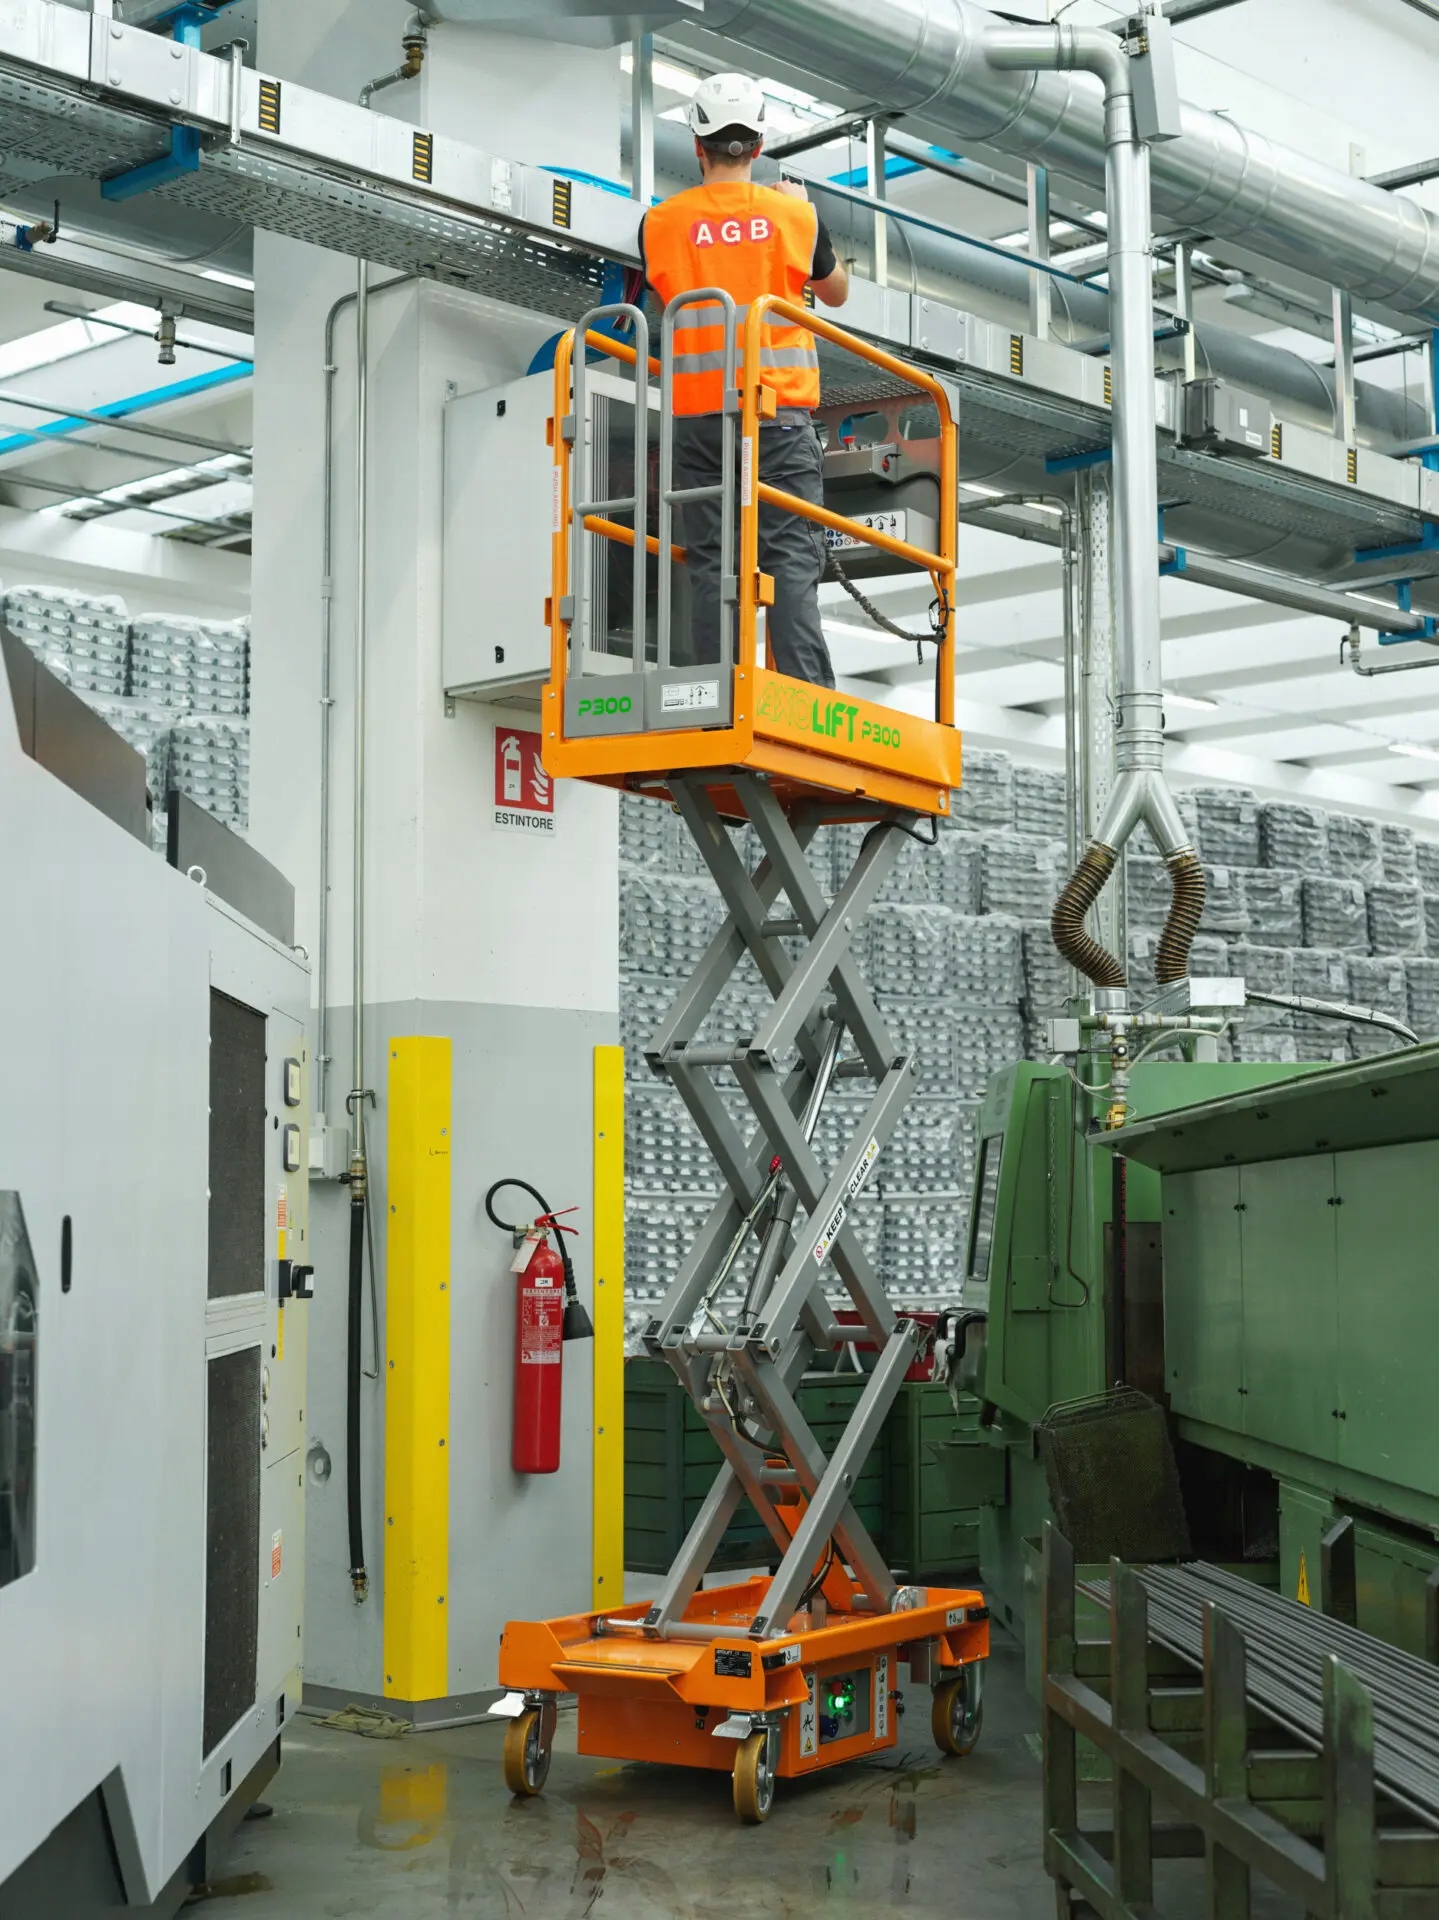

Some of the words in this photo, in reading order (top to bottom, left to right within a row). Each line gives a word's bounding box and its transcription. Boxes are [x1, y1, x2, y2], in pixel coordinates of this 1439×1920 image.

[695, 219, 769, 245] AGB
[578, 696, 632, 717] P300
[861, 720, 901, 749] P300
[495, 811, 554, 830] ESTINTORE
[826, 1207, 844, 1241] KEEP
[849, 1159, 870, 1194] CLEAR
